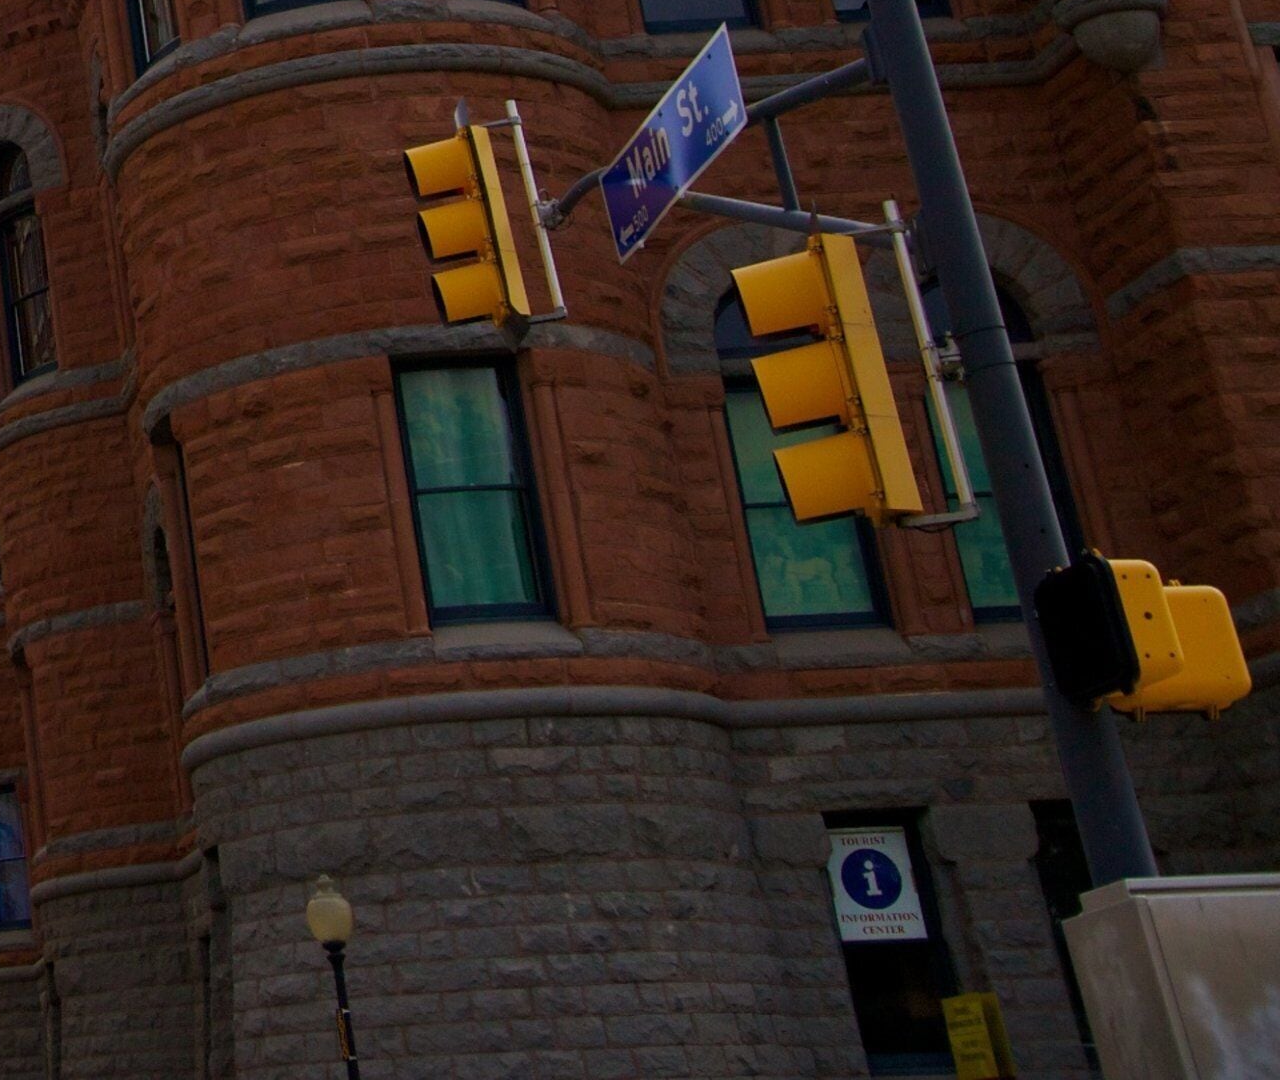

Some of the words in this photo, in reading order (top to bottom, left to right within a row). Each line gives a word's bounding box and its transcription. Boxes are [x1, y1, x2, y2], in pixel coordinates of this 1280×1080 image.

[706, 117, 724, 146] 400
[626, 126, 671, 198] Main
[676, 80, 709, 137] St.
[841, 836, 886, 846] TOURIST
[841, 912, 919, 922] INFORMATION
[862, 925, 906, 934] CENTER
